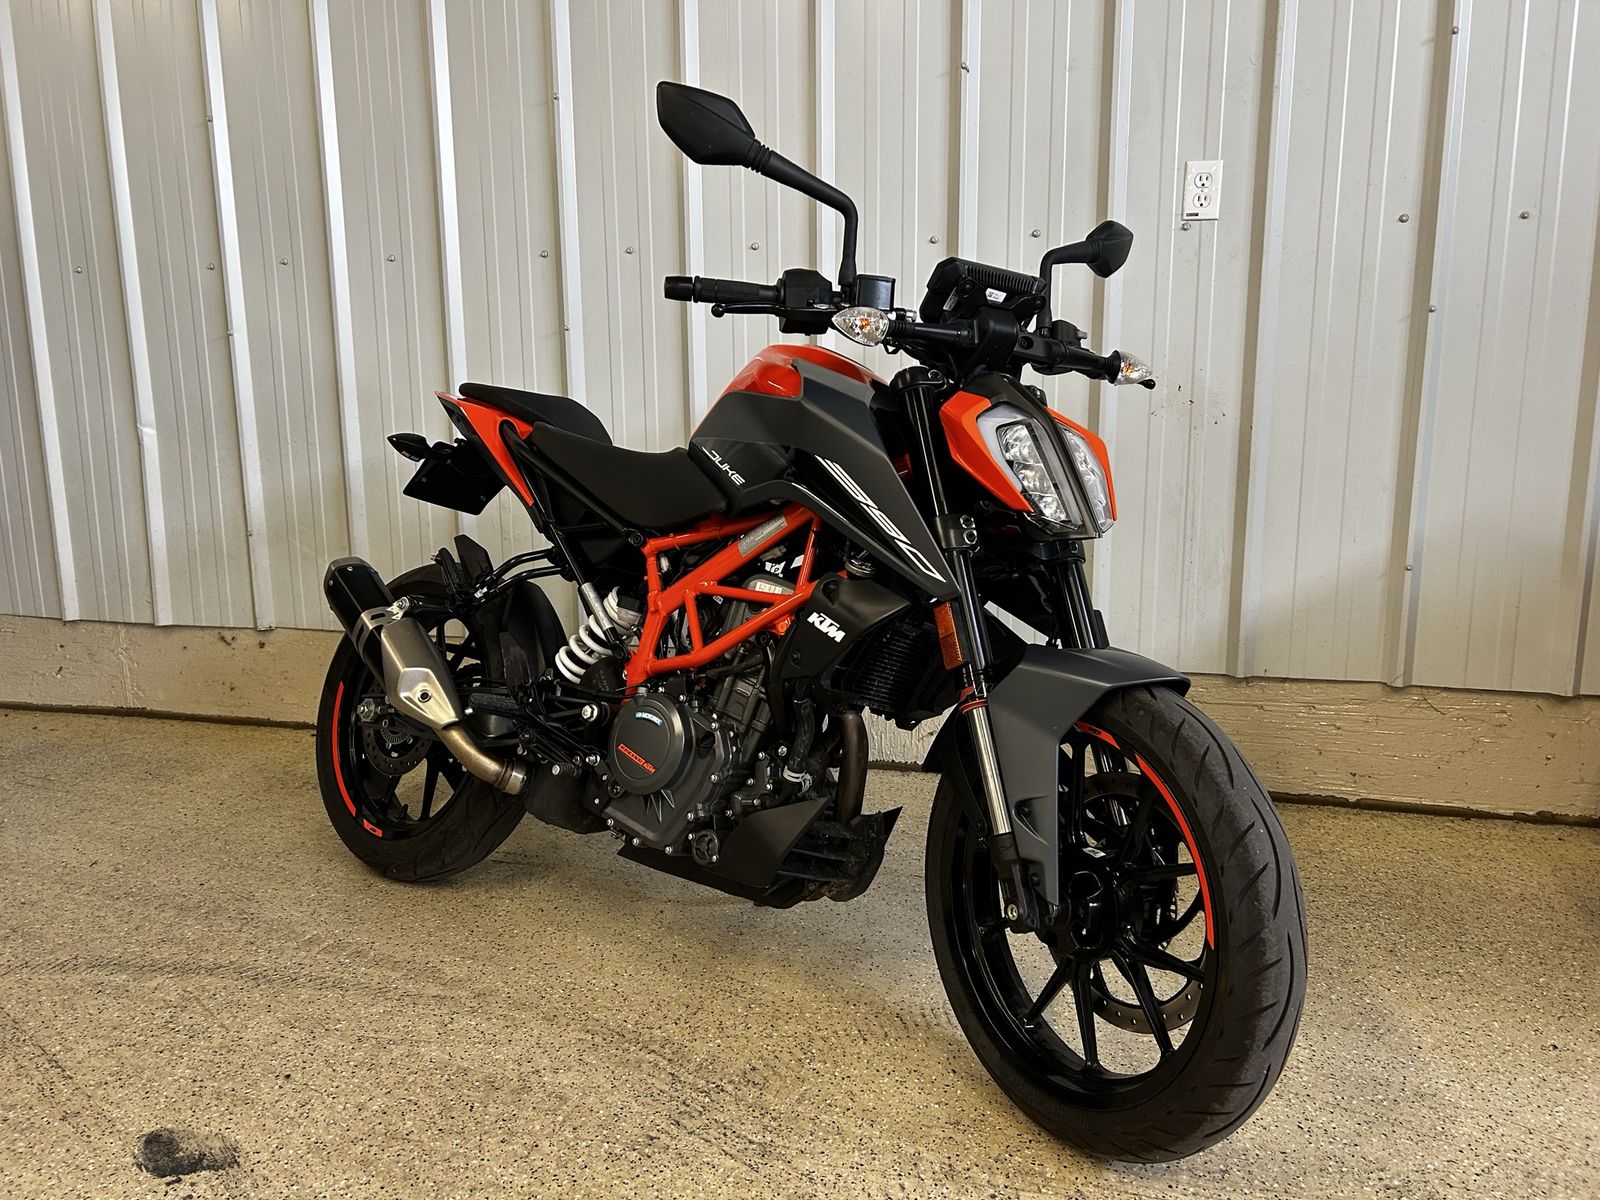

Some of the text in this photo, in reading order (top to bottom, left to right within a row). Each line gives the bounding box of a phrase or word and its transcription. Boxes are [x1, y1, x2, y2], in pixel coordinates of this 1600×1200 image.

[702, 446, 746, 485] DUKE
[814, 455, 947, 582] 390
[807, 612, 846, 643] KTM
